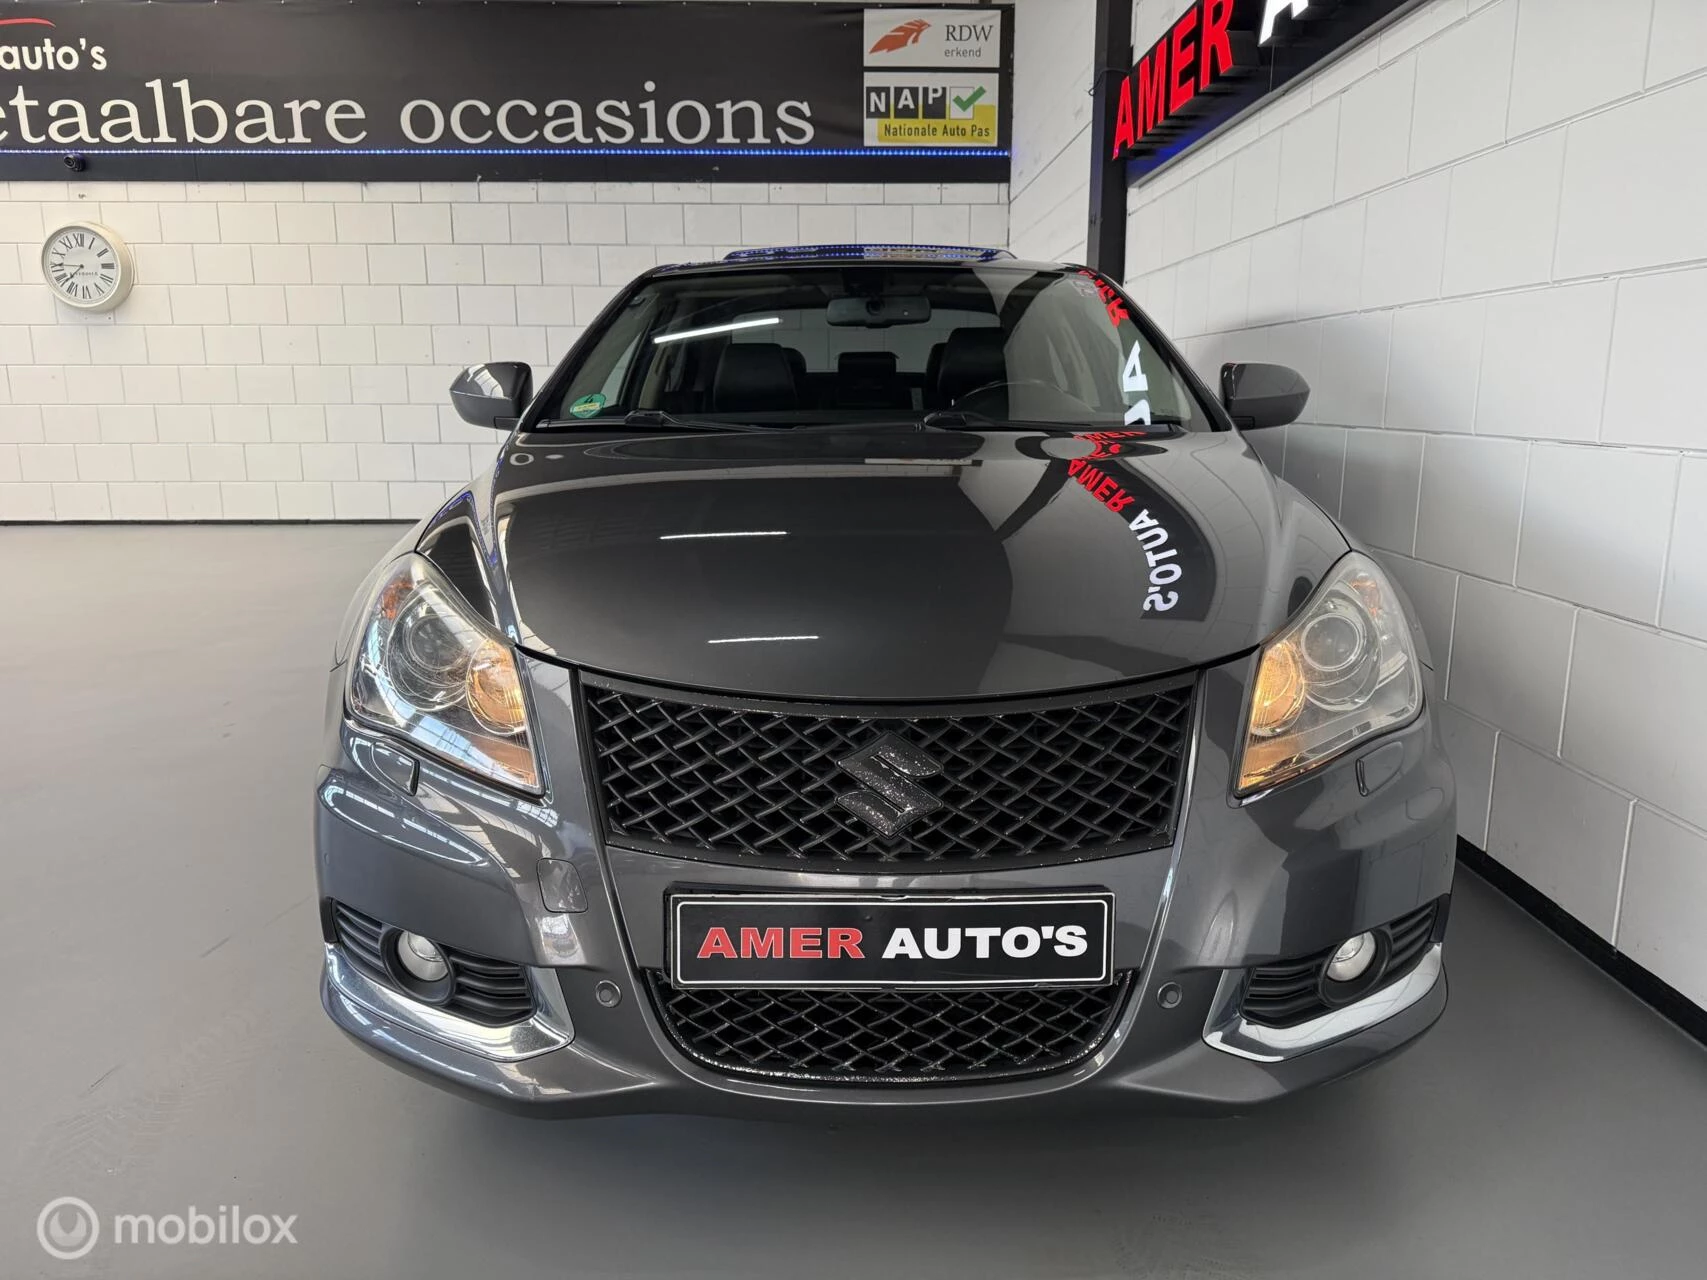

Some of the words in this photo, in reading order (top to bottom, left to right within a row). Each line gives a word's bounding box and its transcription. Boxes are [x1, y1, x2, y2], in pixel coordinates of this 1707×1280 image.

[945, 24, 994, 42] RDW
[0, 37, 107, 70] auto's
[944, 47, 982, 57] erkend
[1112, 0, 1235, 161] AMER
[0, 79, 368, 144] taalbare
[400, 81, 815, 144] occasions
[869, 86, 943, 113] NAP
[884, 124, 938, 137] Nationale
[942, 124, 967, 137] Auto
[971, 124, 990, 137] Pas
[697, 927, 865, 959] AMER
[881, 925, 1088, 960] AUTO'S
